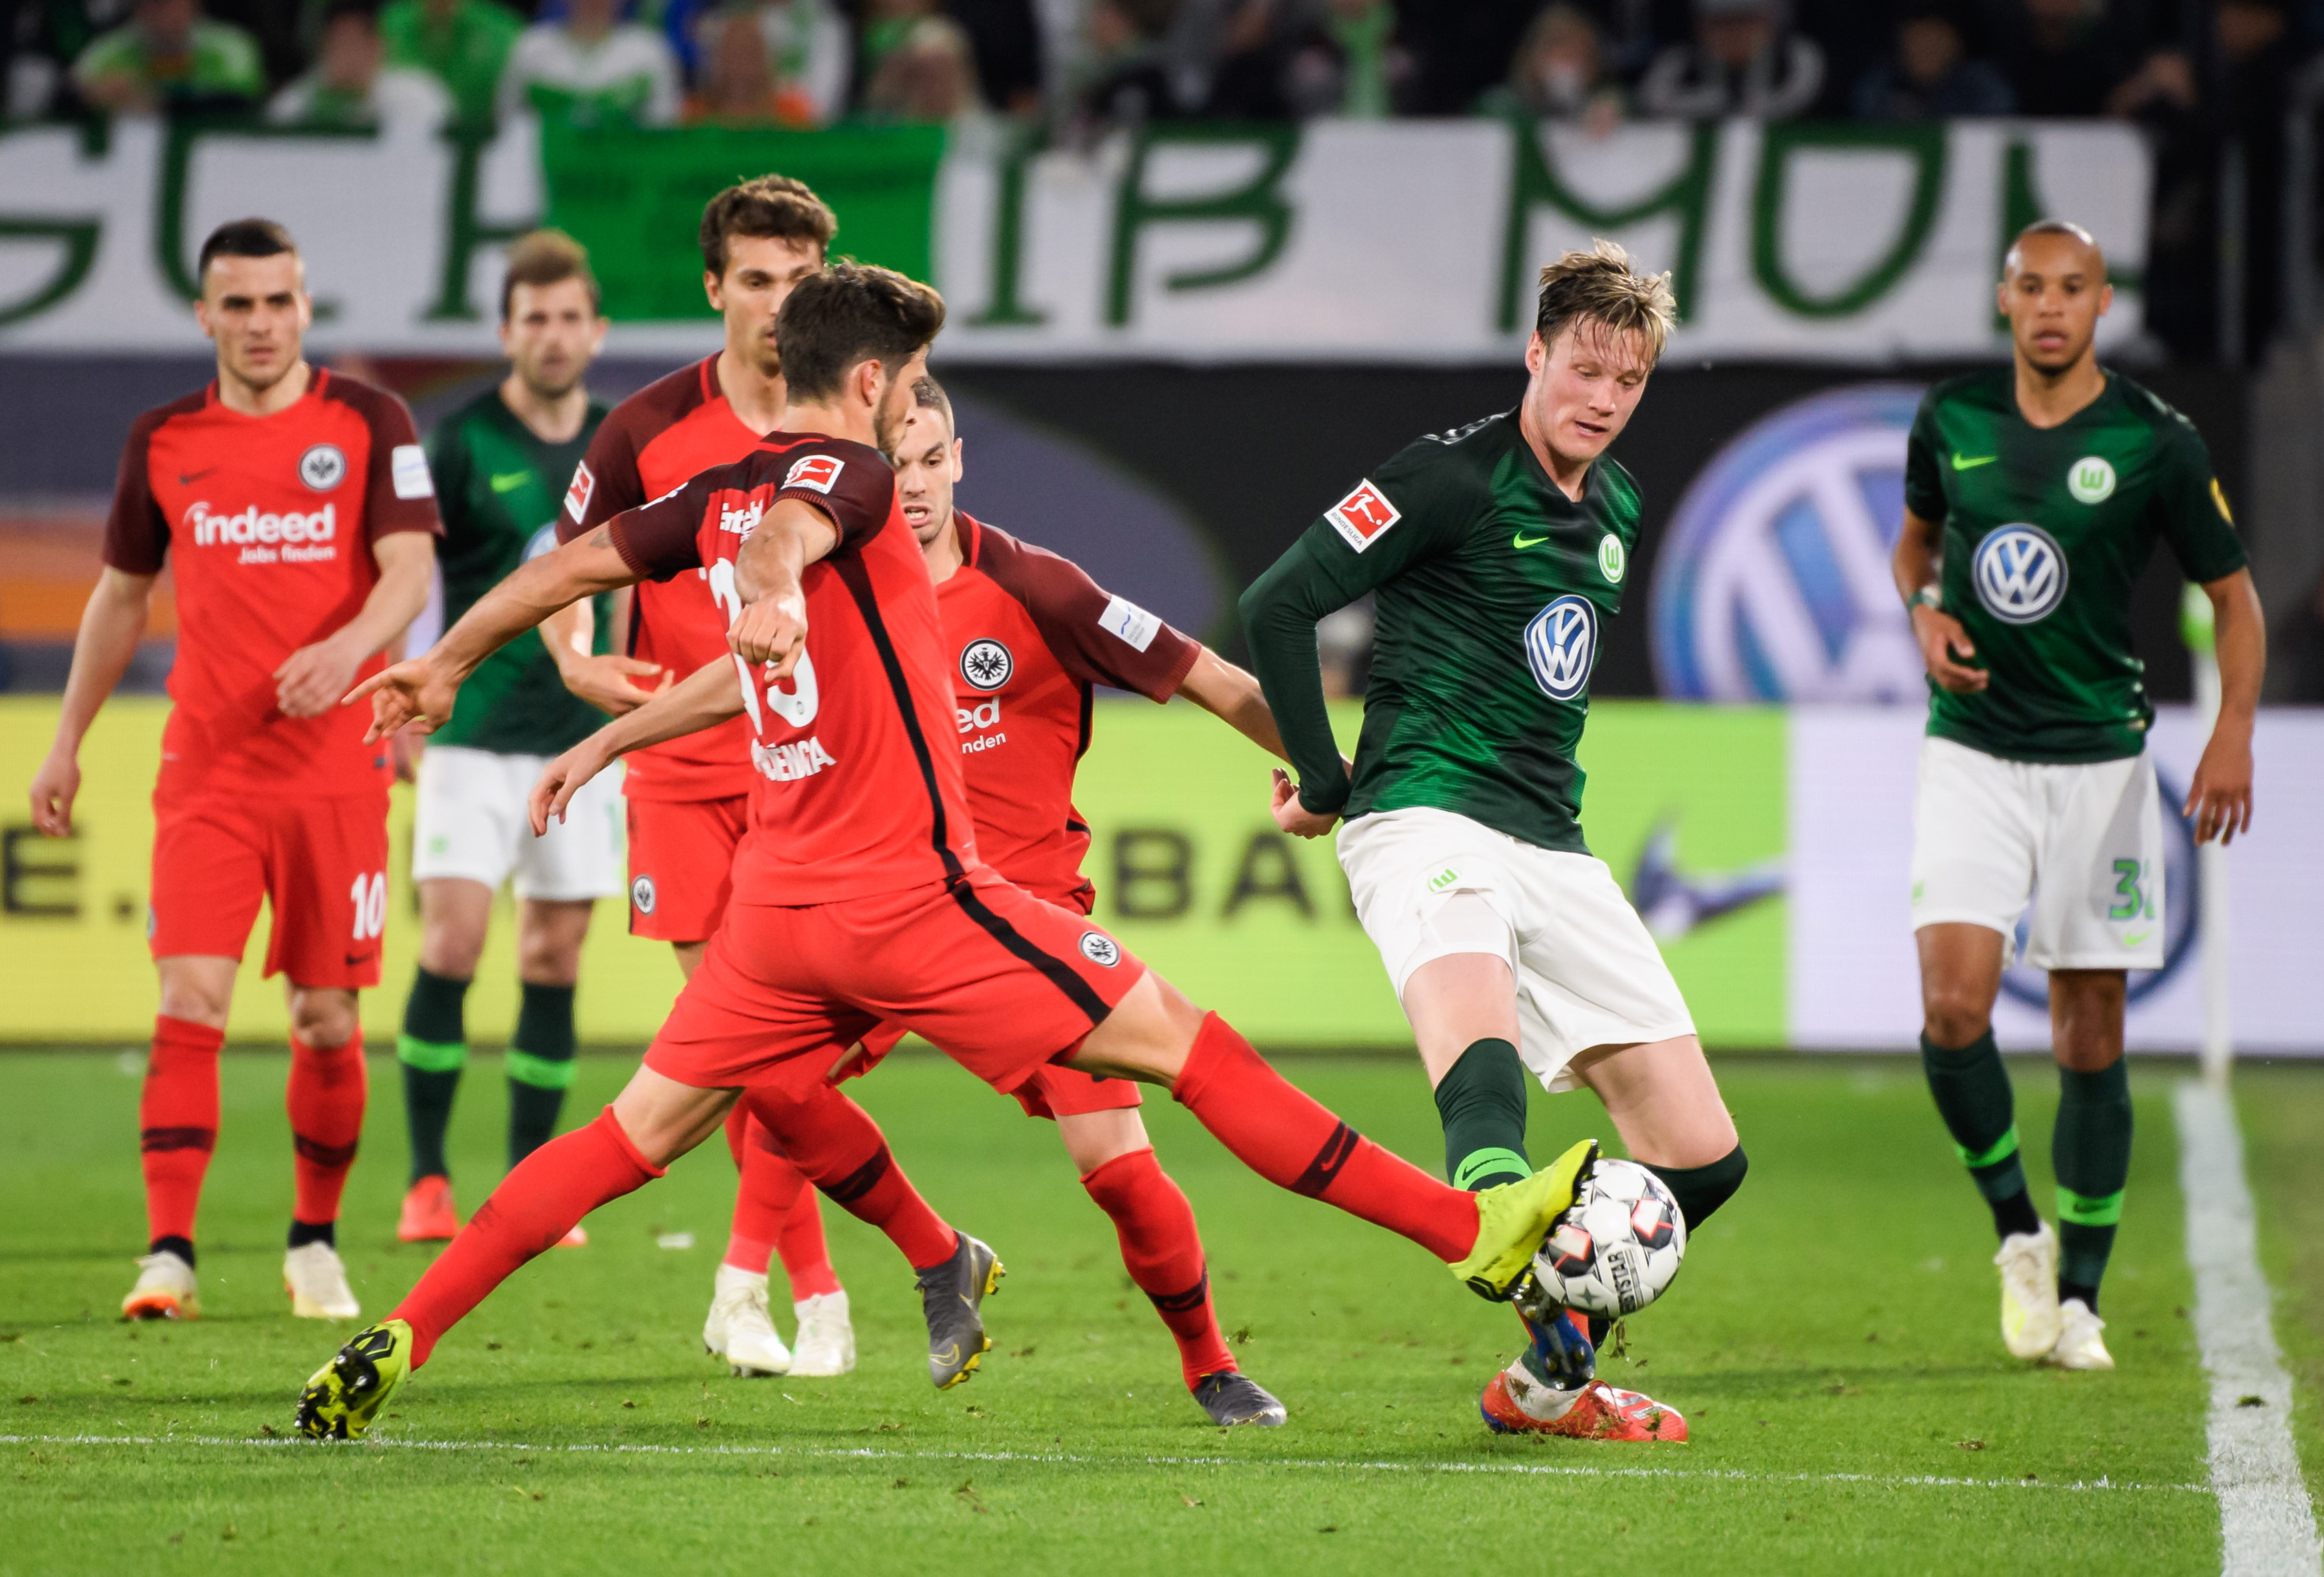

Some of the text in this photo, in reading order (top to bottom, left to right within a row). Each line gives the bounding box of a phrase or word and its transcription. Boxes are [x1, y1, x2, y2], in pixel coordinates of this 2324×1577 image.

[186, 503, 336, 547] indeed
[1330, 511, 1363, 546] BUNDESLIGA
[237, 543, 337, 565] Jobs finden
[350, 871, 387, 940] 10
